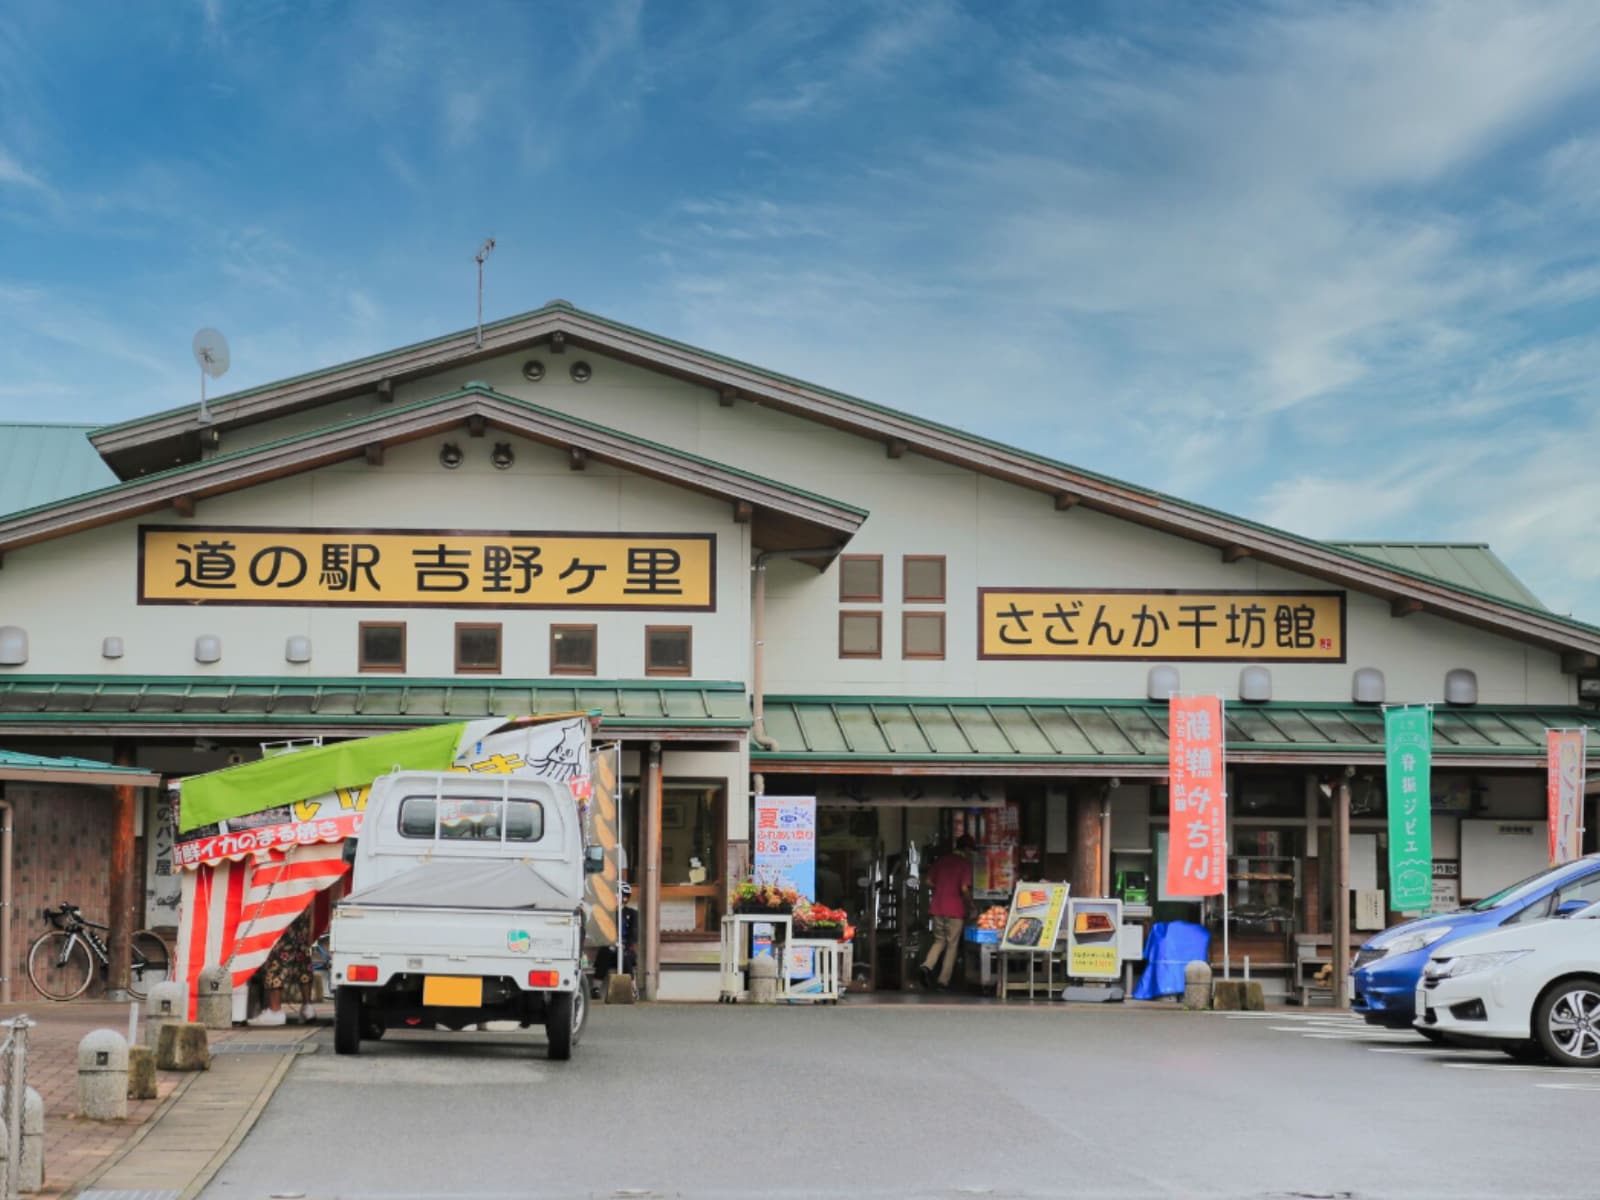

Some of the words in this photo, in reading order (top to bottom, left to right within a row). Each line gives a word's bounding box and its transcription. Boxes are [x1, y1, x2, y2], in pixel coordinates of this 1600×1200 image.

[174, 540, 382, 593] 道の駅
[412, 543, 684, 596] 吉野ヶ里
